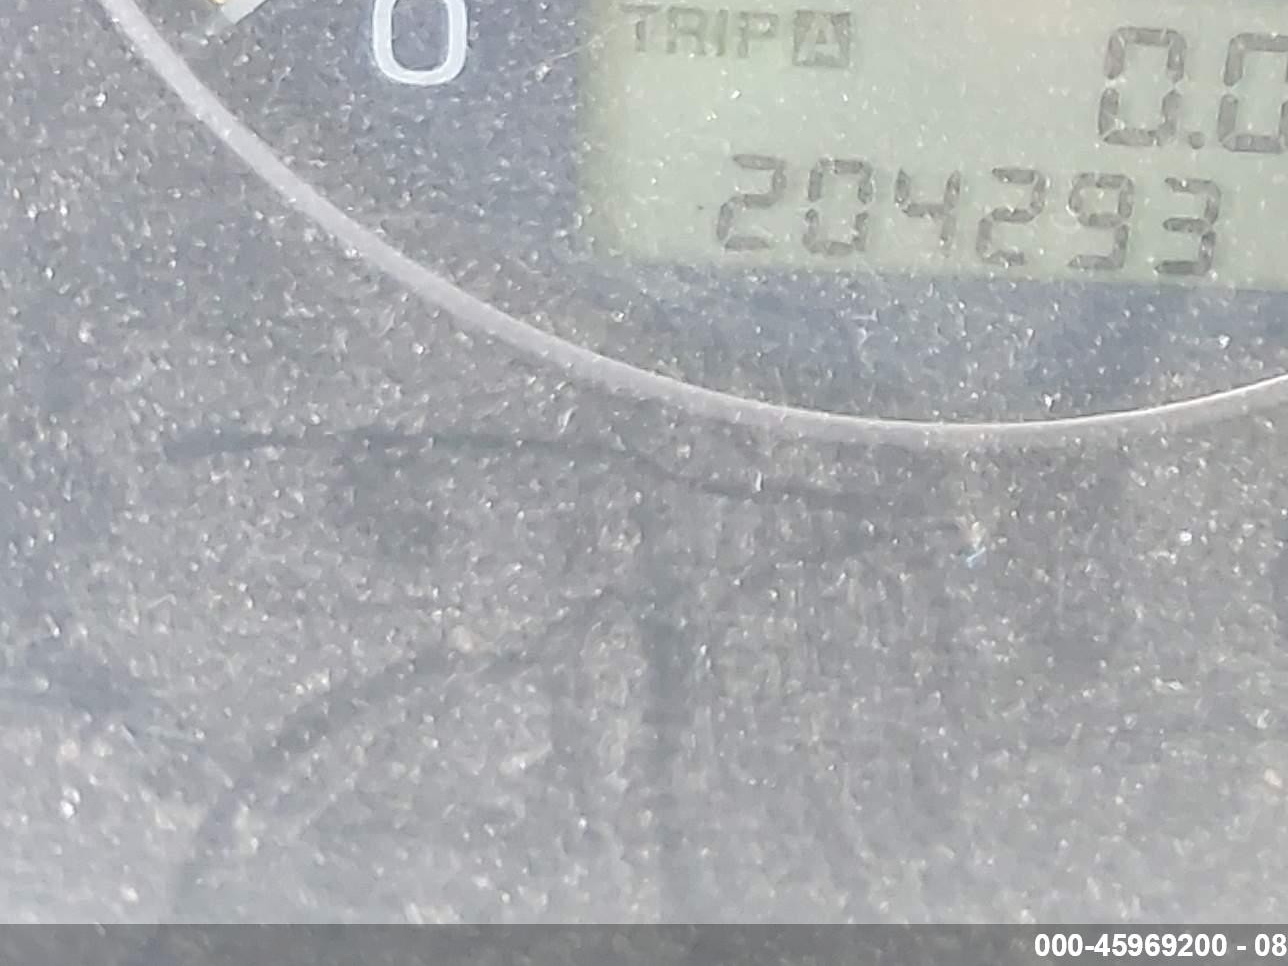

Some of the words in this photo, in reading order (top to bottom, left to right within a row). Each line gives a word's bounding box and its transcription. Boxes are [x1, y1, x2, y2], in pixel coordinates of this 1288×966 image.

[618, 4, 778, 60] TRIP
[794, 10, 852, 68] A
[716, 153, 1222, 277] 204293
